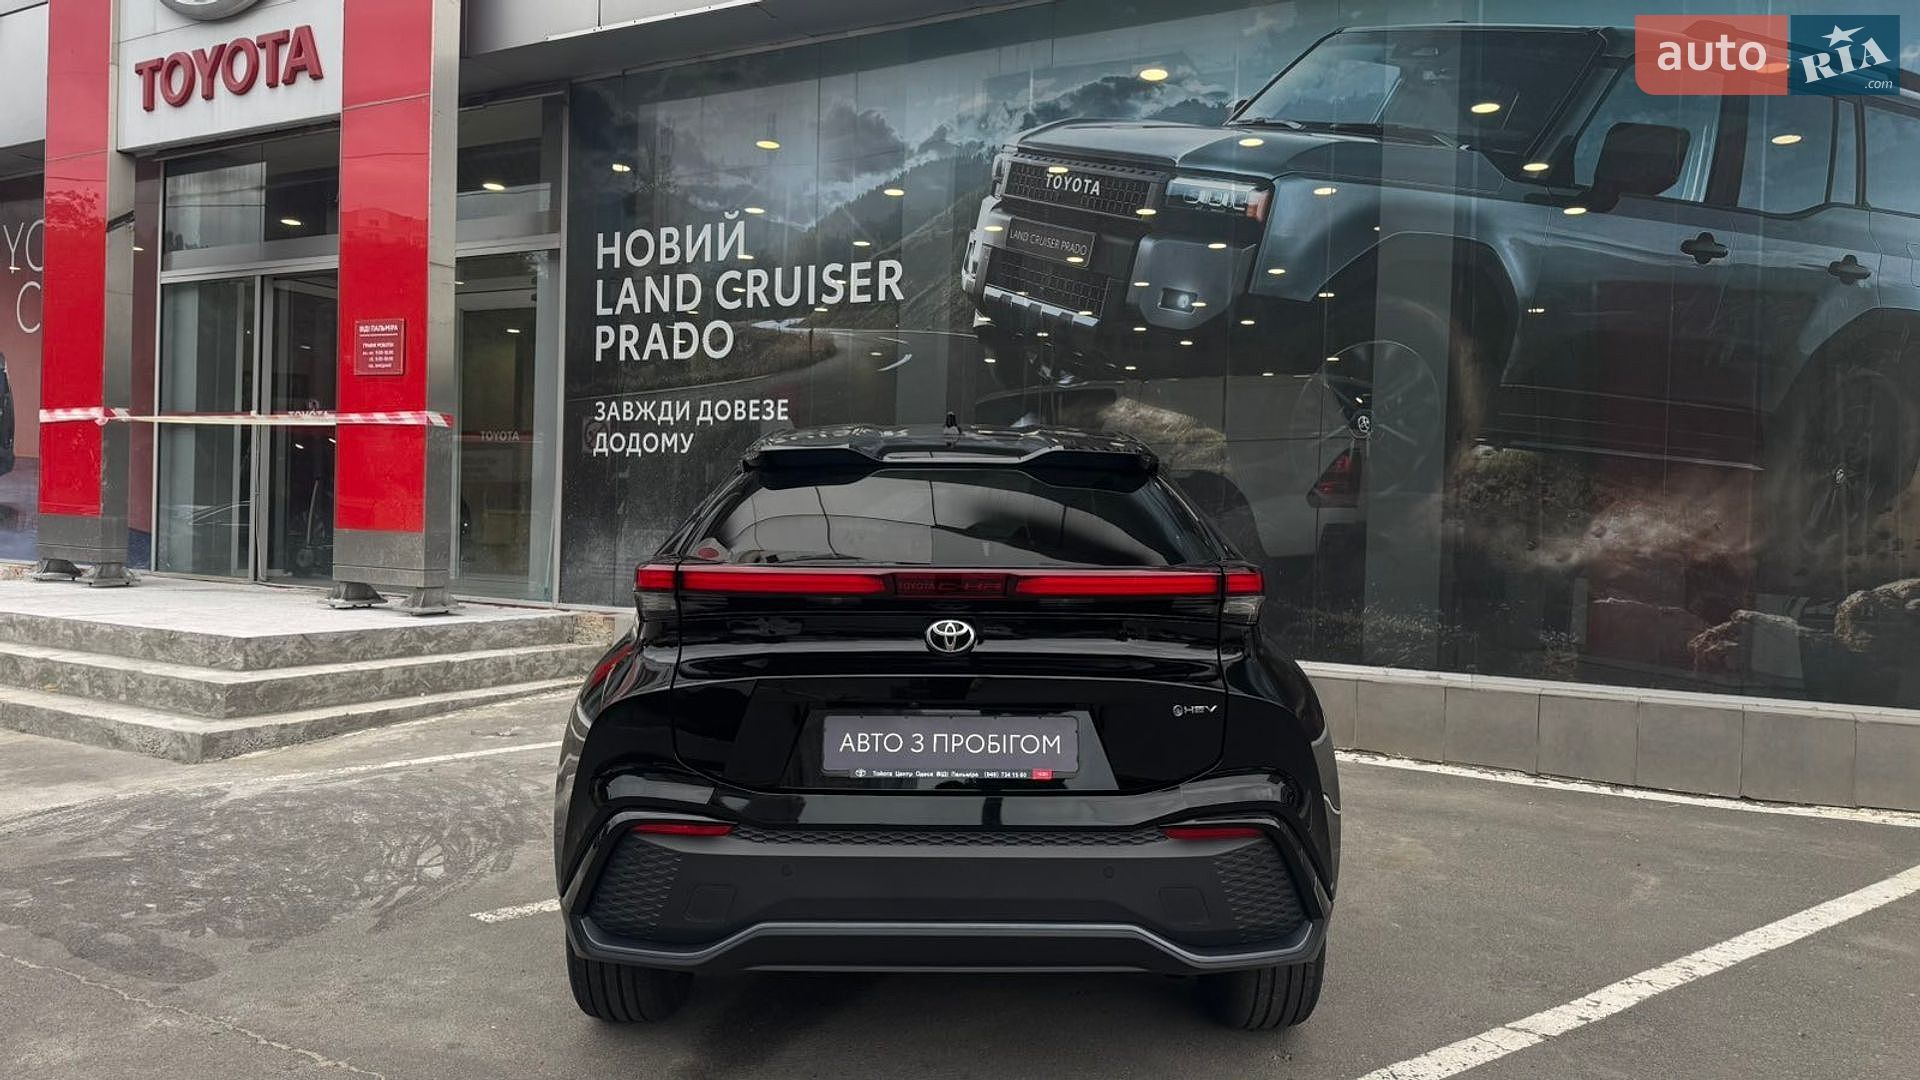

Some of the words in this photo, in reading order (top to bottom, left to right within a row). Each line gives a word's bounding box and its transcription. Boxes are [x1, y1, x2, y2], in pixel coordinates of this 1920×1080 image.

[135, 25, 324, 112] TOYOTA
[1046, 173, 1101, 196] TOYOTA
[596, 210, 746, 270] НОВИЙ
[1010, 230, 1029, 241] LAND
[1060, 241, 1088, 256] PRADO
[596, 273, 703, 316] LAND
[715, 259, 905, 310] CRUISER
[595, 320, 735, 362] PRADO
[594, 401, 690, 426] ЗАВЖДИ
[696, 399, 789, 426] ДОВЕЗЕ
[480, 430, 520, 441] TOYOTA
[593, 432, 694, 457] ДОДОМУ
[839, 732, 903, 753] АВТО
[932, 733, 1061, 754] ПРОБІГОМ
